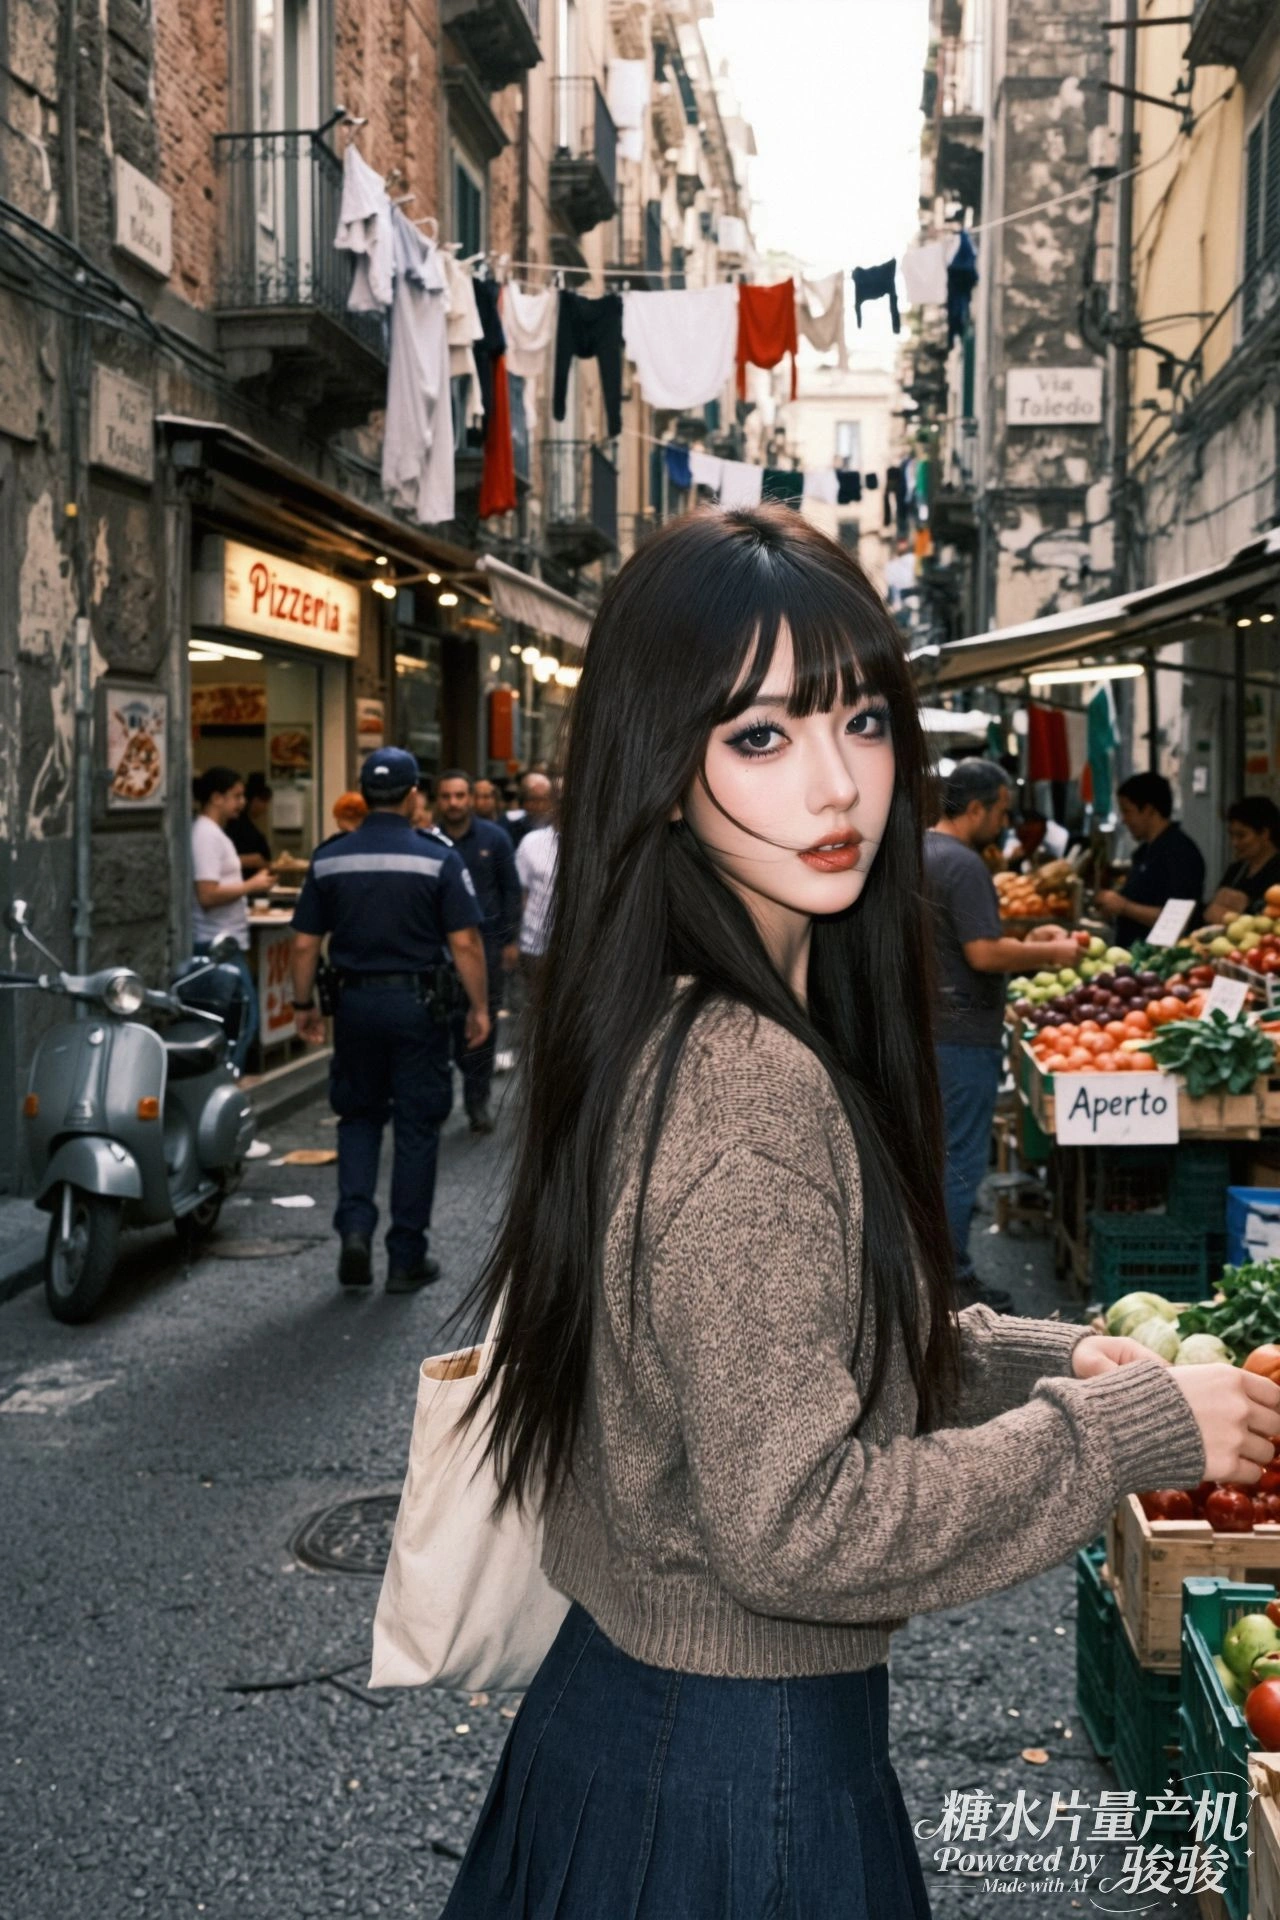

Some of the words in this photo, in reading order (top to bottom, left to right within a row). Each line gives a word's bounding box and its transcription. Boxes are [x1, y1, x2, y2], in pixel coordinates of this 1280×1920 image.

[1036, 374, 1073, 392] Via
[1017, 397, 1094, 416] Toledo
[249, 562, 339, 632] Pizzeria
[1068, 1086, 1167, 1132] Aperto
